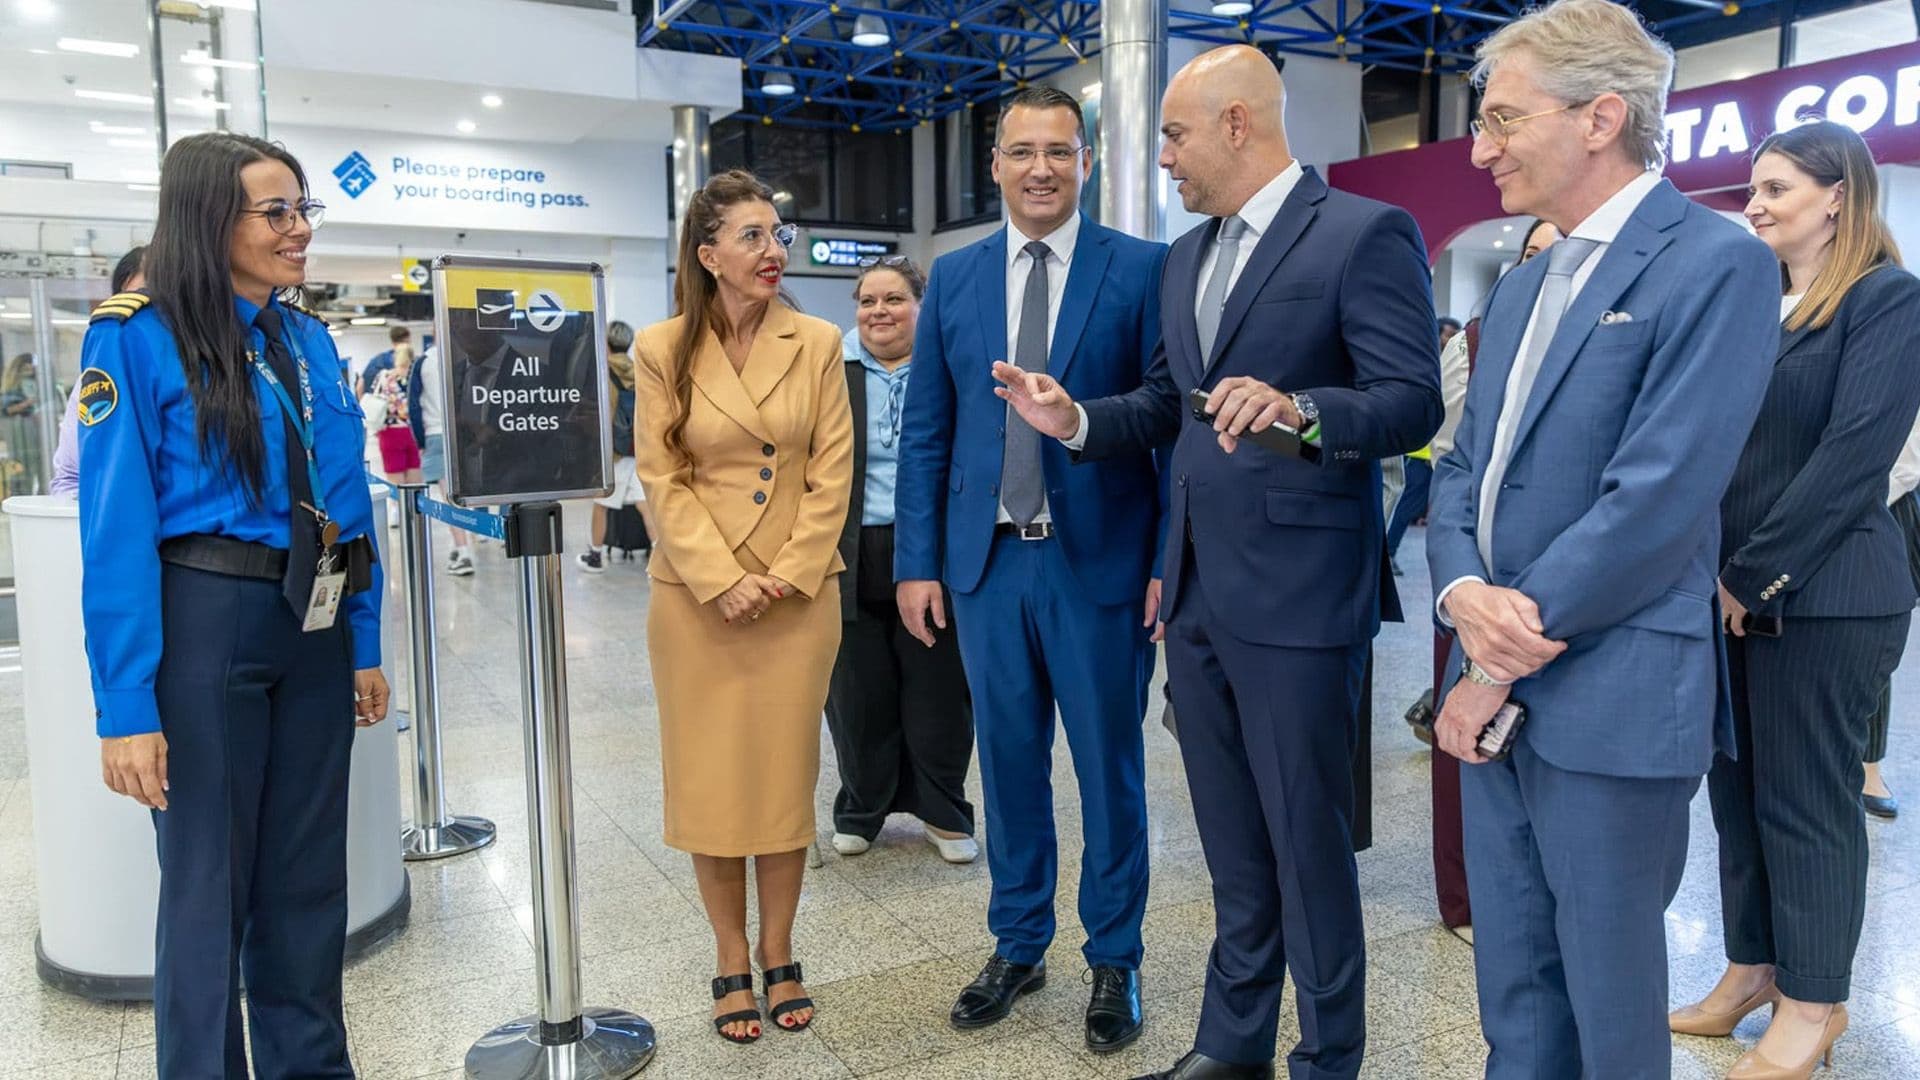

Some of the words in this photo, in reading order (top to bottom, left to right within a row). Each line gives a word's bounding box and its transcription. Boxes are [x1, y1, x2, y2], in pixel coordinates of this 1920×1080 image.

[393, 157, 461, 177] Please
[467, 165, 546, 183] prepare
[393, 183, 438, 200] your
[445, 184, 536, 208] boarding
[541, 192, 590, 208] pass.
[511, 356, 540, 377] All
[471, 385, 581, 409] Departure
[498, 412, 560, 432] Gates
